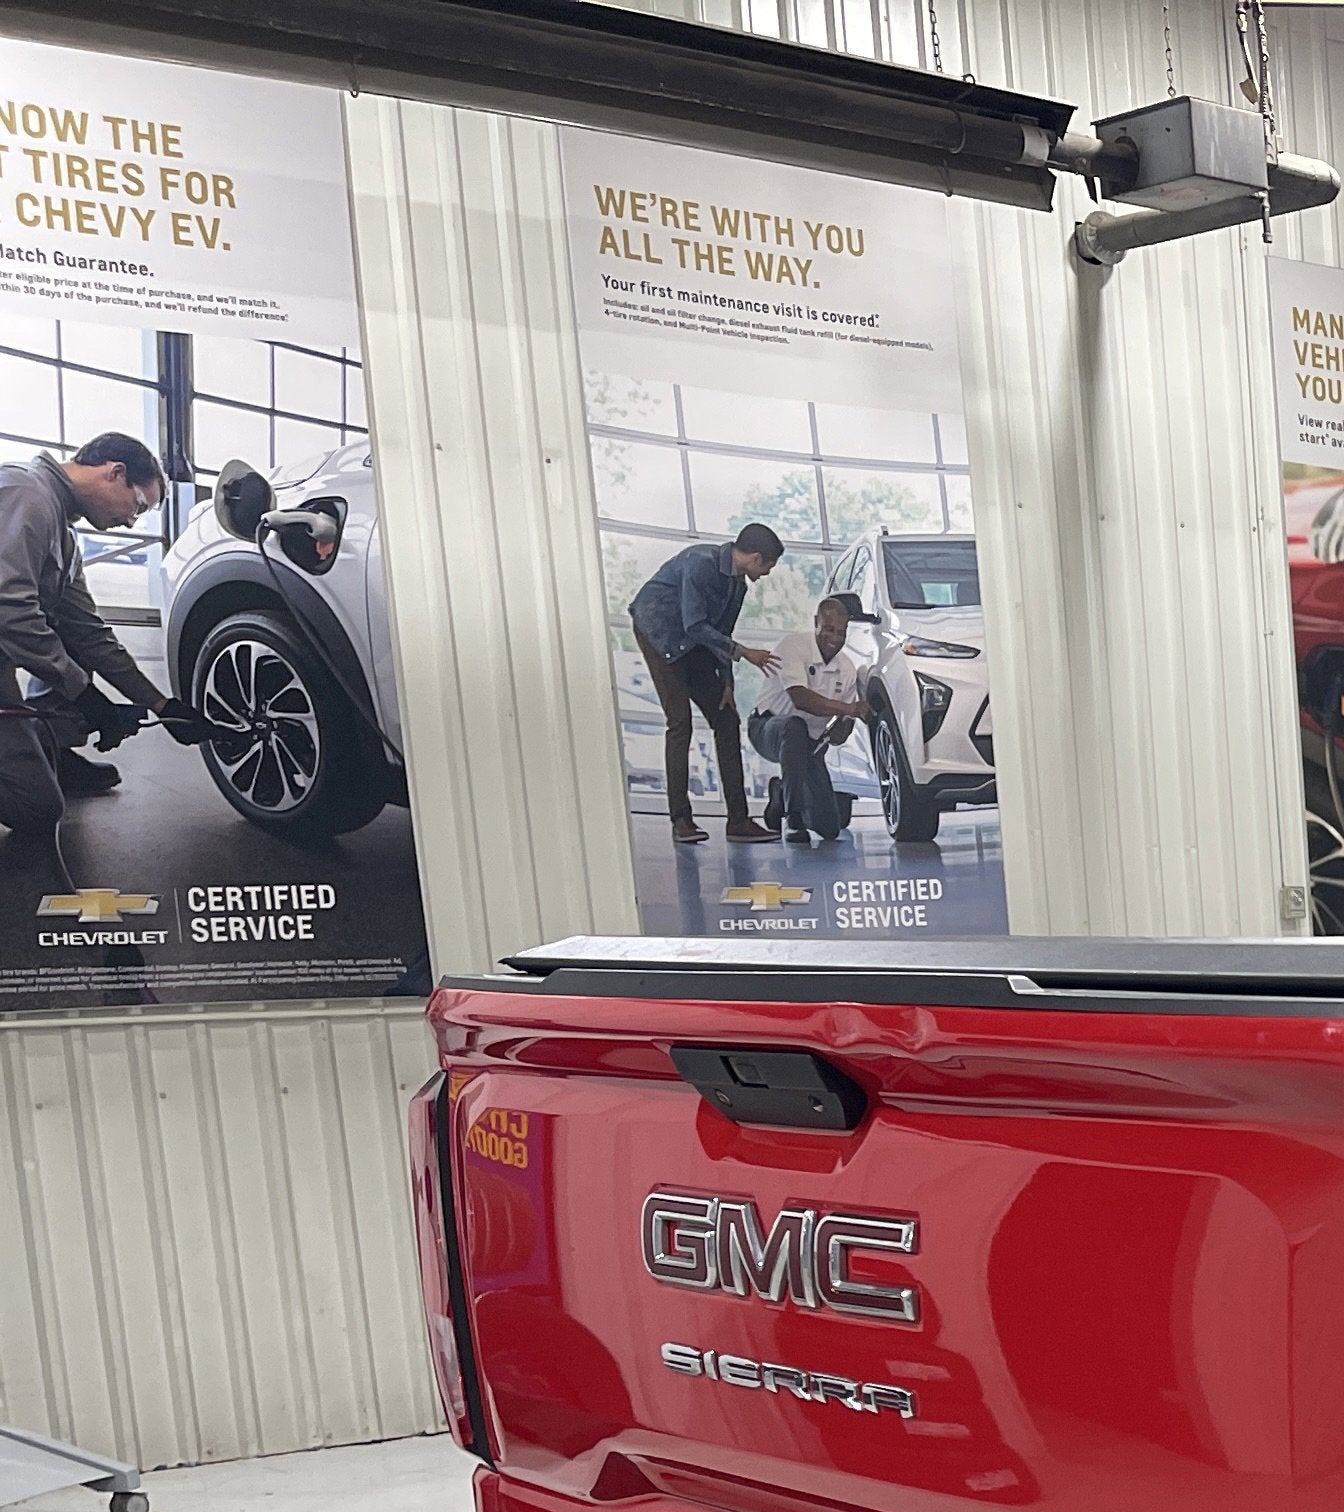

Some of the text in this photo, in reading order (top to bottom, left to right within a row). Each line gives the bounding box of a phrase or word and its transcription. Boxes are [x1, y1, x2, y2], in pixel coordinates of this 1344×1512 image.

[102, 114, 184, 158] THE
[22, 147, 146, 197] TIRES
[160, 165, 236, 208] FOR
[15, 192, 232, 251] CHEVY EV.
[594, 185, 866, 259] WE'RE WITH YOU
[0, 243, 154, 276] atch Guarantee.
[599, 225, 821, 289] ALL THE WAY.
[15, 272, 51, 285] eligible
[54, 276, 78, 289] price
[81, 279, 92, 289] at
[93, 280, 110, 291] the
[112, 282, 134, 294] time
[136, 286, 146, 296] of
[149, 289, 195, 302] purchase,
[197, 292, 214, 302] and
[239, 297, 268, 307] match
[24, 283, 36, 294] 30
[38, 285, 62, 300] days
[64, 289, 74, 299] of
[76, 290, 92, 302] the
[95, 295, 142, 309] purchase,
[144, 300, 162, 310] and
[188, 304, 218, 315] refund
[220, 306, 236, 317] the
[600, 273, 635, 293] Your
[640, 279, 673, 299] first
[677, 289, 770, 313] maintenance
[772, 301, 803, 319] visit
[806, 305, 818, 321] is
[640, 302, 649, 312] oil
[651, 305, 665, 315] and
[677, 307, 696, 320] filter
[728, 315, 750, 328] diesel
[751, 320, 780, 332] exhaust
[781, 322, 798, 334] fluid
[799, 325, 815, 337] tank
[816, 328, 834, 339] refill
[663, 318, 677, 328] and
[679, 319, 720, 334] Multi-Point
[721, 325, 748, 338] Vehicle
[1297, 413, 1323, 428] View
[187, 884, 336, 912] CERTIFIED
[833, 878, 942, 902] CERTIFIED
[191, 915, 314, 942] SERVICE
[719, 918, 818, 930] CHEVROLET
[836, 905, 928, 928] SERVICE
[38, 930, 168, 946] CHEVROLET
[640, 1183, 920, 1323] GMC
[660, 1341, 917, 1419] SIERRA
